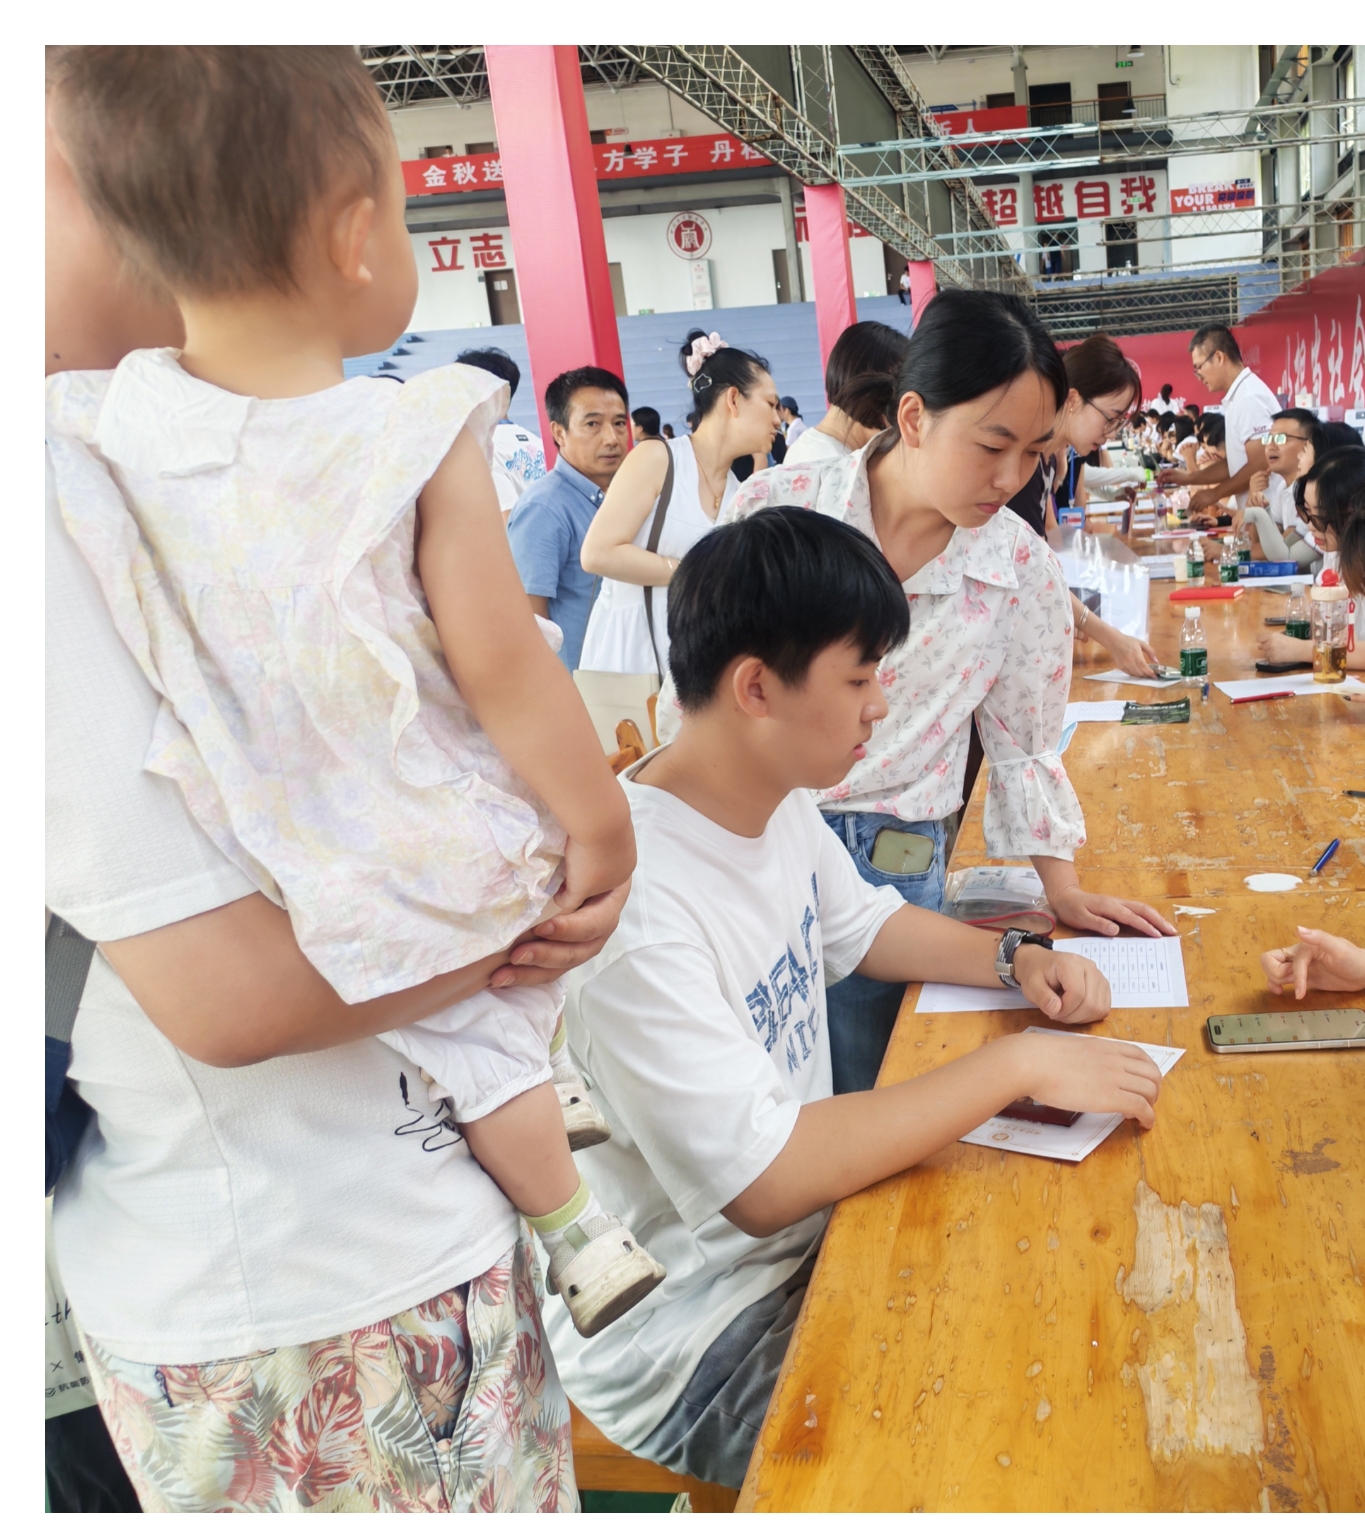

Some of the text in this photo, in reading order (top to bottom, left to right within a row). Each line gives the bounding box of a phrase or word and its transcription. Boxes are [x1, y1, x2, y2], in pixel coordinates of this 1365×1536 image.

[982, 175, 1157, 226] 超越自我
[1174, 193, 1215, 207] YOUR
[428, 232, 507, 272] 立志
